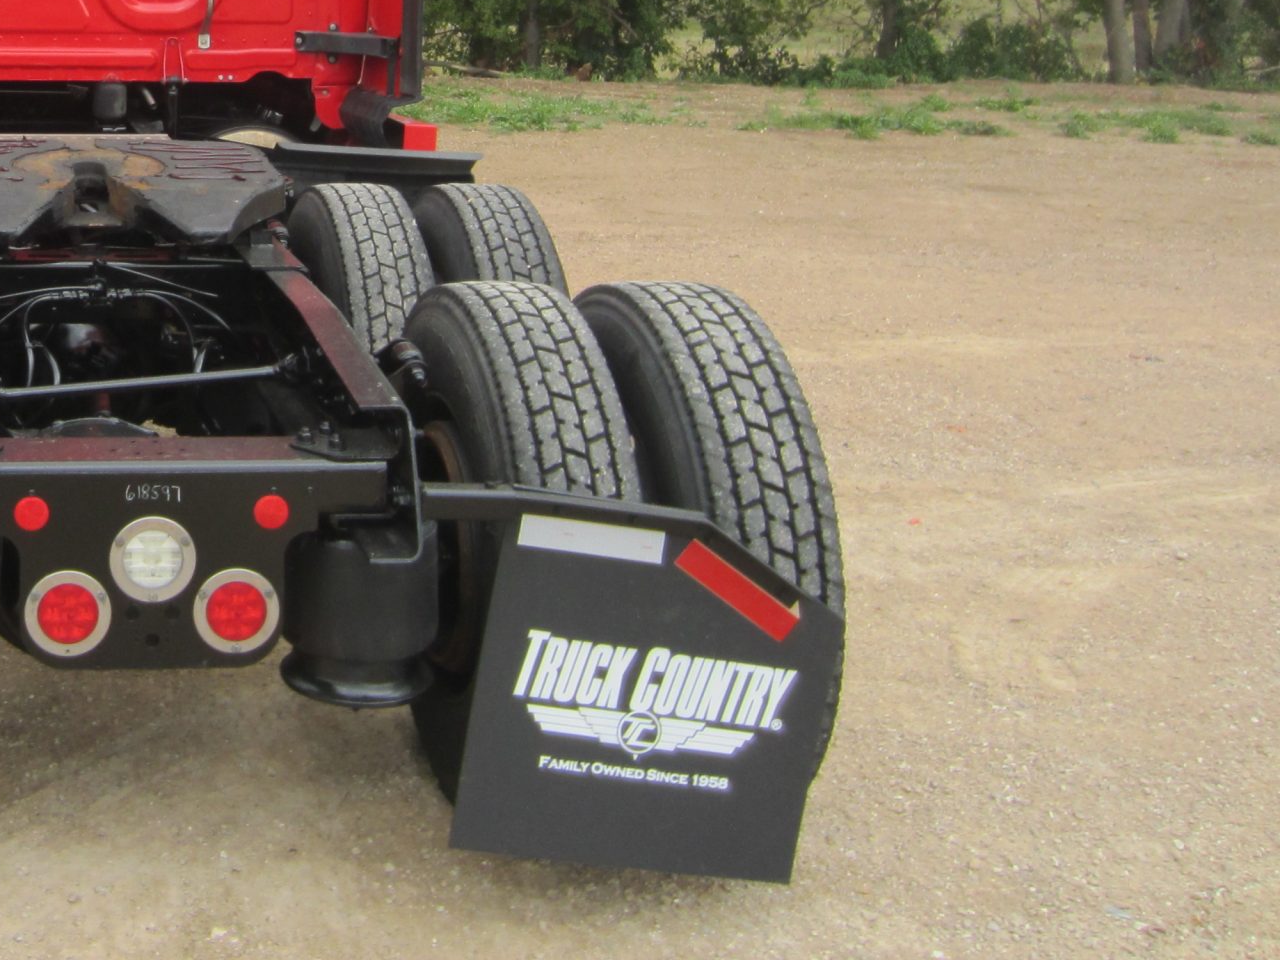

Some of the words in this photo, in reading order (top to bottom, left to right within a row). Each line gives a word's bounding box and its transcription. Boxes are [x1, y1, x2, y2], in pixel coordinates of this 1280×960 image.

[125, 483, 181, 503] 618597
[513, 629, 638, 708] TRUCK
[630, 647, 797, 729] COUNTRY
[538, 755, 589, 773] FAMILY
[591, 762, 644, 780] OWNED
[646, 769, 689, 785] SINCE
[692, 774, 728, 790] 1958
